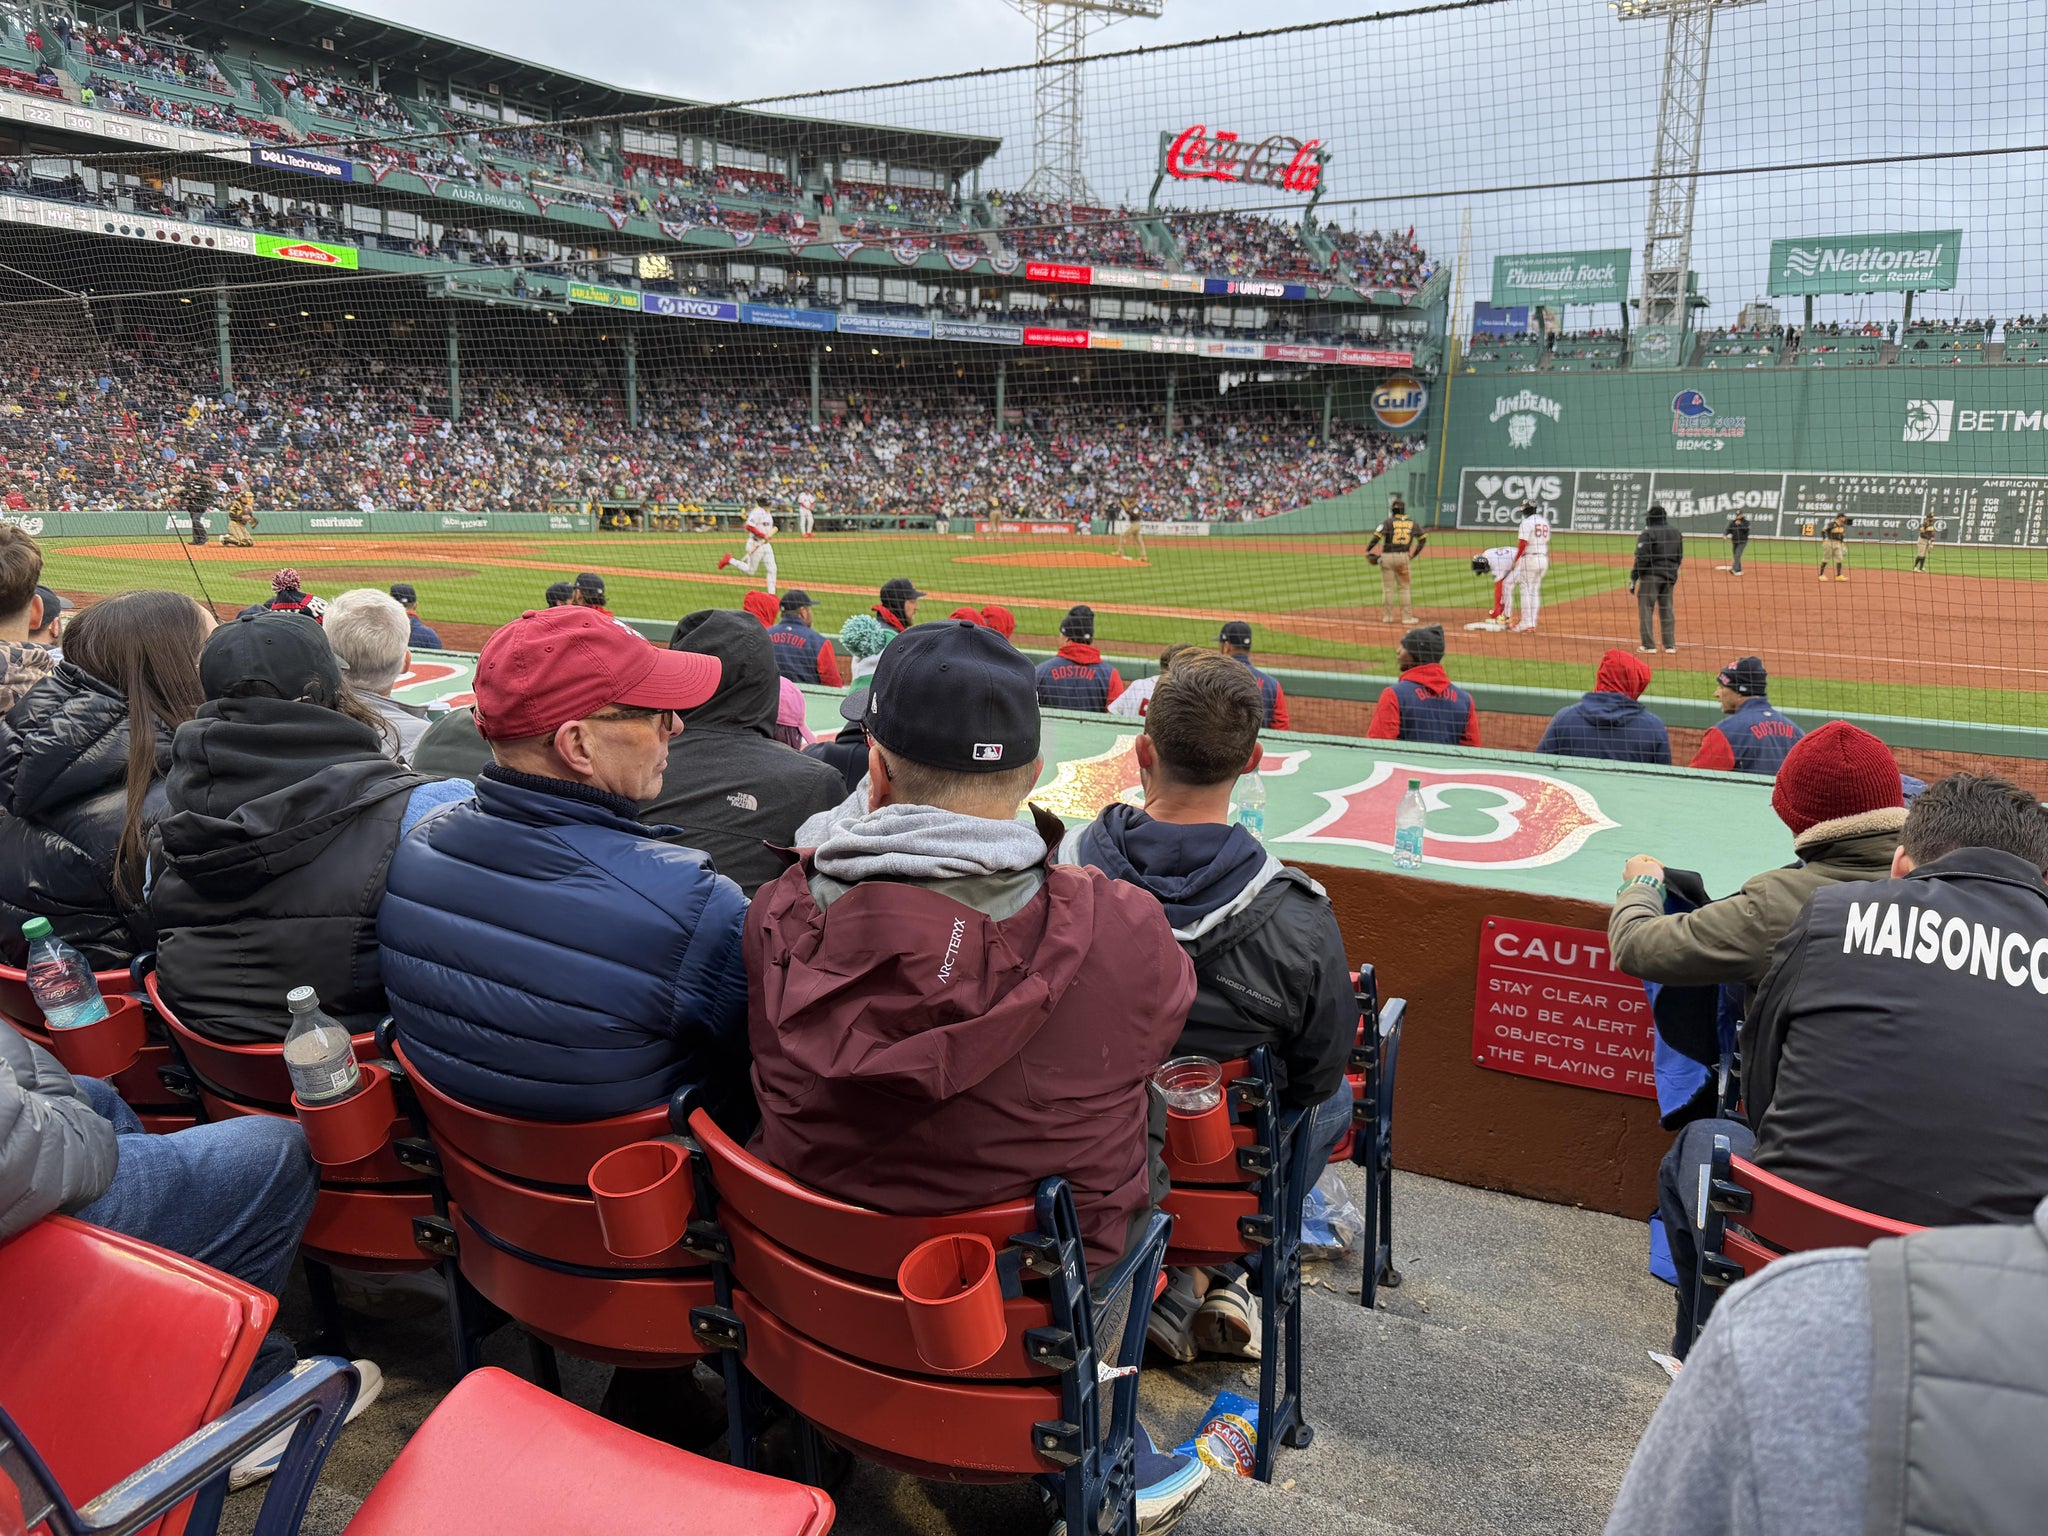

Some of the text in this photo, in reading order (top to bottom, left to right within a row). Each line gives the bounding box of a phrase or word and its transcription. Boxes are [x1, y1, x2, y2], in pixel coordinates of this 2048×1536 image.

[26, 109, 51, 121] .222
[68, 117, 91, 129] .300
[106, 125, 130, 137] .333
[145, 132, 167, 144] .633
[261, 150, 342, 175] DELL Technologies
[22, 201, 29, 210] 5
[484, 193, 525, 211] PAVILION
[47, 210, 87, 223] MVR 3
[112, 214, 249, 249] BALL STRIKE OUT 3RD
[288, 248, 327, 260] SERVPRO
[1819, 244, 1943, 272] National
[1506, 263, 1616, 286] Plymouth Rock
[1858, 269, 1933, 283] Car Rental
[1239, 282, 1285, 297] UNITED
[677, 301, 718, 316] HYCU
[1374, 391, 1422, 409] Gulf
[1489, 389, 1563, 423] JIM BEAM
[1678, 427, 1745, 437] SCHOLARS
[1676, 440, 1712, 450] BIDMC
[1502, 475, 1562, 500] CVS
[1819, 476, 1929, 486] FENWAY PARK
[1983, 480, 2039, 488] AMERICAN
[1655, 489, 1693, 499] WHO BUT
[1863, 485, 1869, 493] 4
[1805, 502, 1834, 510] BOSTON
[310, 517, 363, 528] smartwater
[461, 519, 488, 529] TICKET
[1852, 519, 1880, 527] STRIKE
[1882, 520, 1900, 528] OUT
[1535, 524, 1549, 538] 68
[1978, 534, 1994, 542] DET
[1979, 527, 1994, 535] STL
[1051, 664, 1096, 681] BOSTON
[1750, 720, 1794, 740] BOSTON
[1216, 974, 1282, 1009] UNDER ARMOUR
[1488, 978, 1647, 1014] STAY CLEAR OF
[1489, 1001, 1528, 1018] AND
[1537, 1009, 1564, 1025] BE
[1572, 1015, 1637, 1036] ALERT
[1494, 1024, 1585, 1051] OBJECTS
[1487, 1045, 1525, 1064] THE
[1534, 1053, 1615, 1080] PLAYING
[1207, 1422, 1253, 1468] PEANUTS
